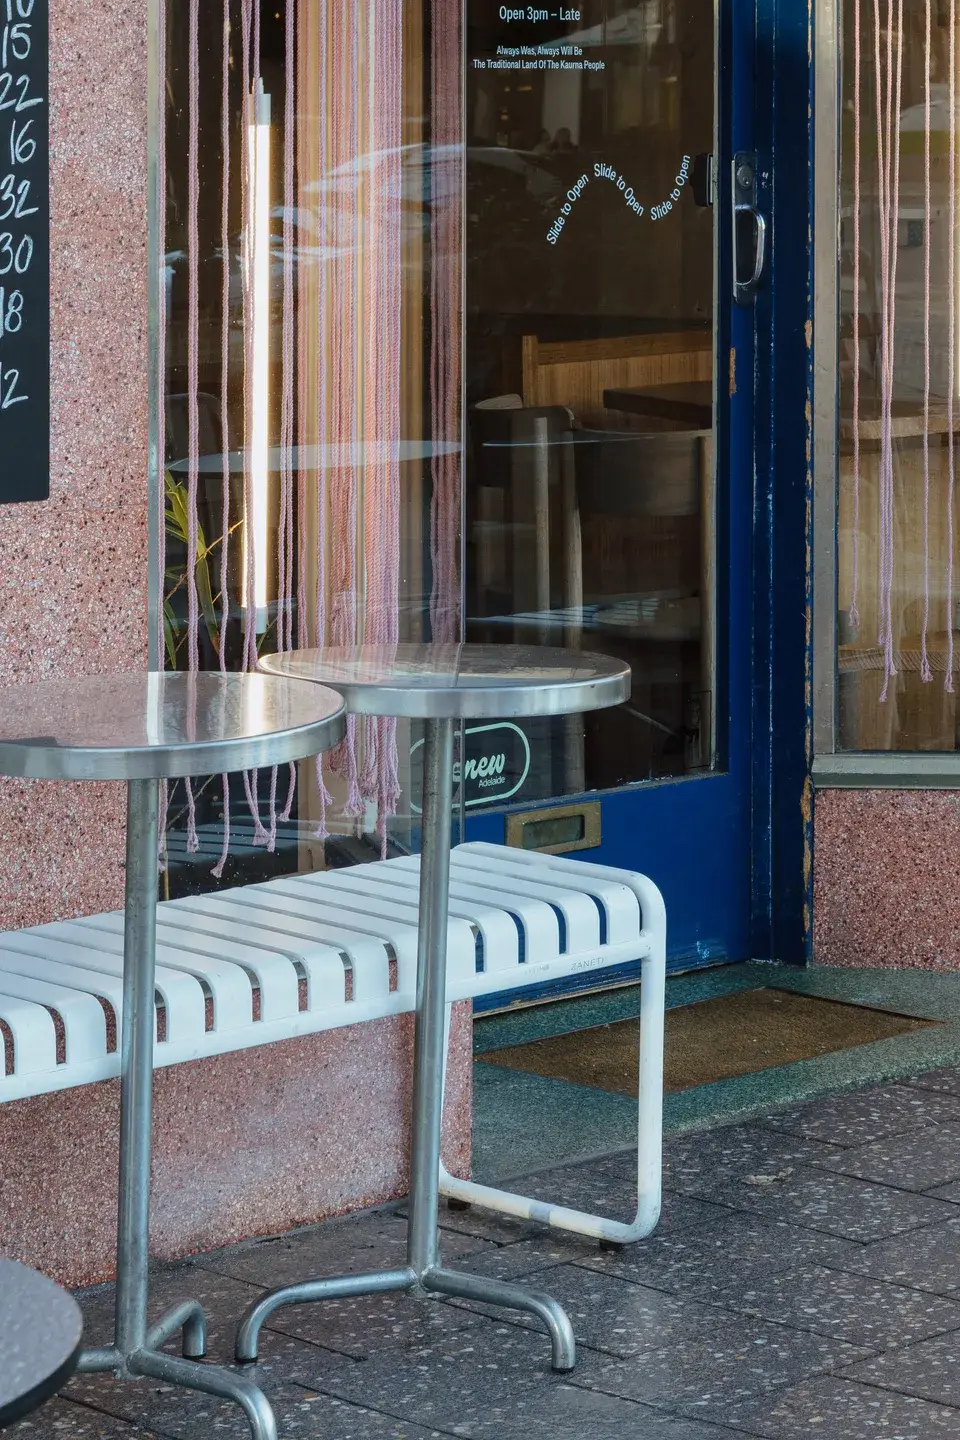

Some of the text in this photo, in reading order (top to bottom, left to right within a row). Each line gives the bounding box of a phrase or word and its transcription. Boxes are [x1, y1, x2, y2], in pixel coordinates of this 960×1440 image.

[499, 5, 525, 23] Open
[527, 6, 549, 23] 3pm
[559, 7, 581, 21] Late
[2, 23, 32, 68] 15
[473, 59, 606, 72] The Traditional Land Of The Kaurna People
[496, 45, 583, 58] Always Was, Always Will Be
[0, 71, 43, 113] 22
[10, 118, 37, 166] 16
[0, 173, 39, 221] 32
[546, 174, 589, 245] Slide to Open
[593, 163, 645, 217] Slide to Open
[650, 154, 691, 221] Slide to Open
[0, 231, 34, 274] 30
[0, 286, 24, 340] 18
[478, 775, 506, 788] Adelaide
